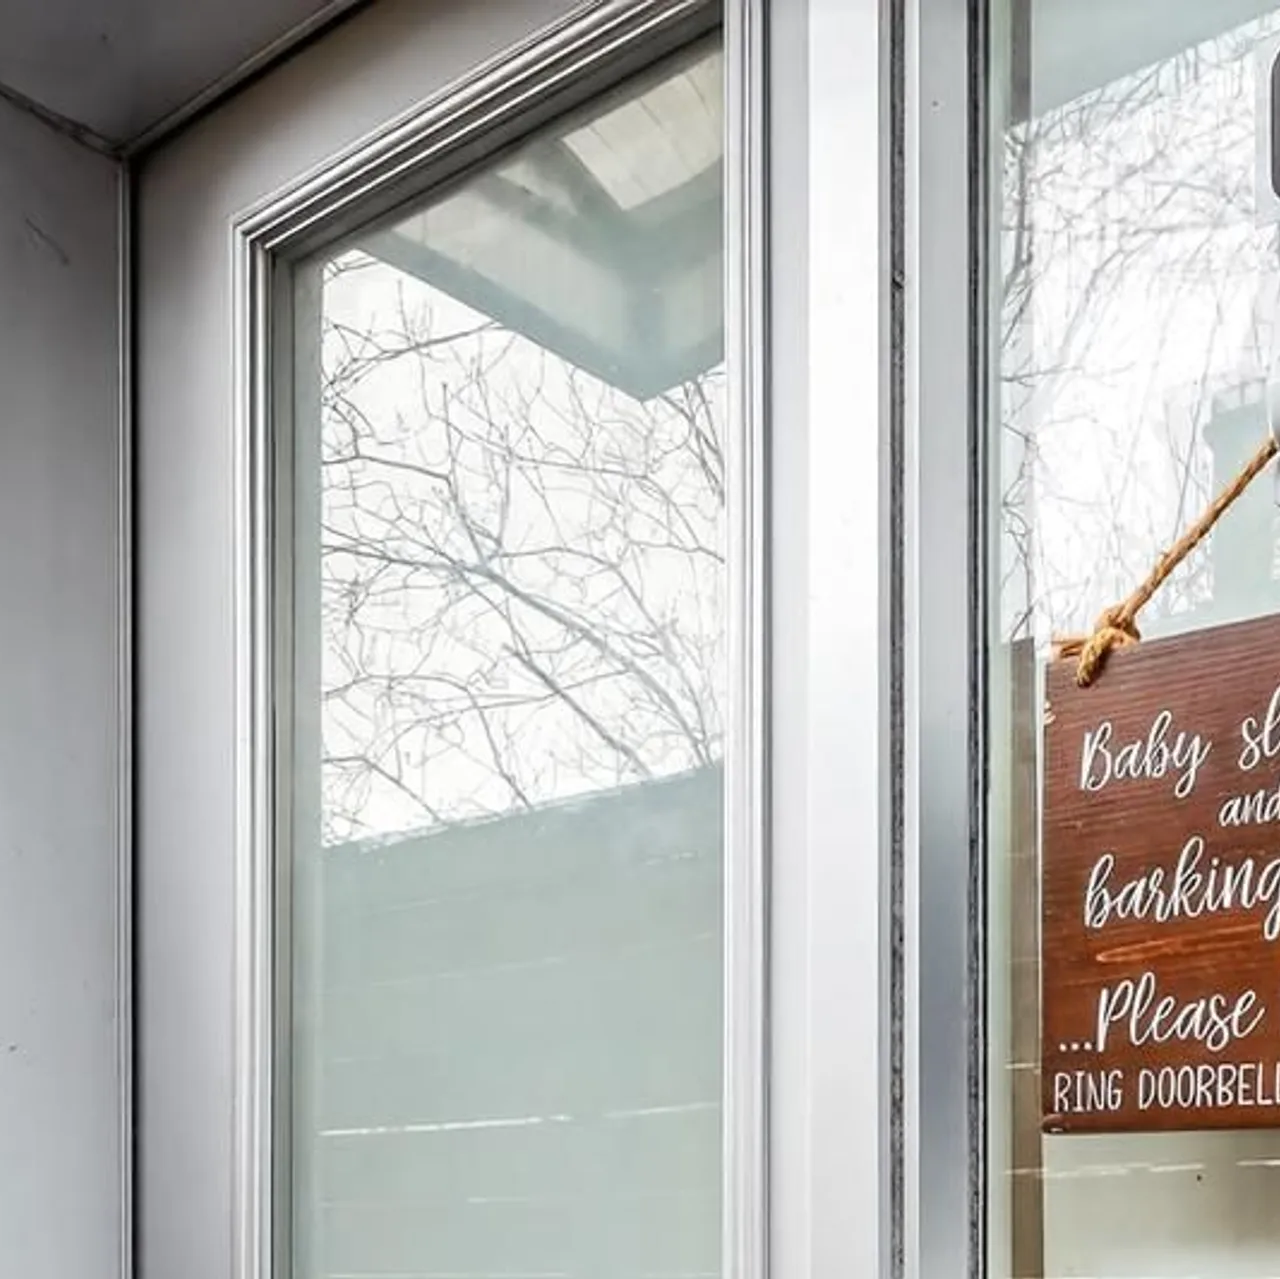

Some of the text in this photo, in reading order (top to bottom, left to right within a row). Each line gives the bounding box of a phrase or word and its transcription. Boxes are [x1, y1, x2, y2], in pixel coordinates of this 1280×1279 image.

[1080, 710, 1212, 798] Baby
[1058, 972, 1266, 1054] ...Please
[1053, 1072, 1124, 1114] RING
